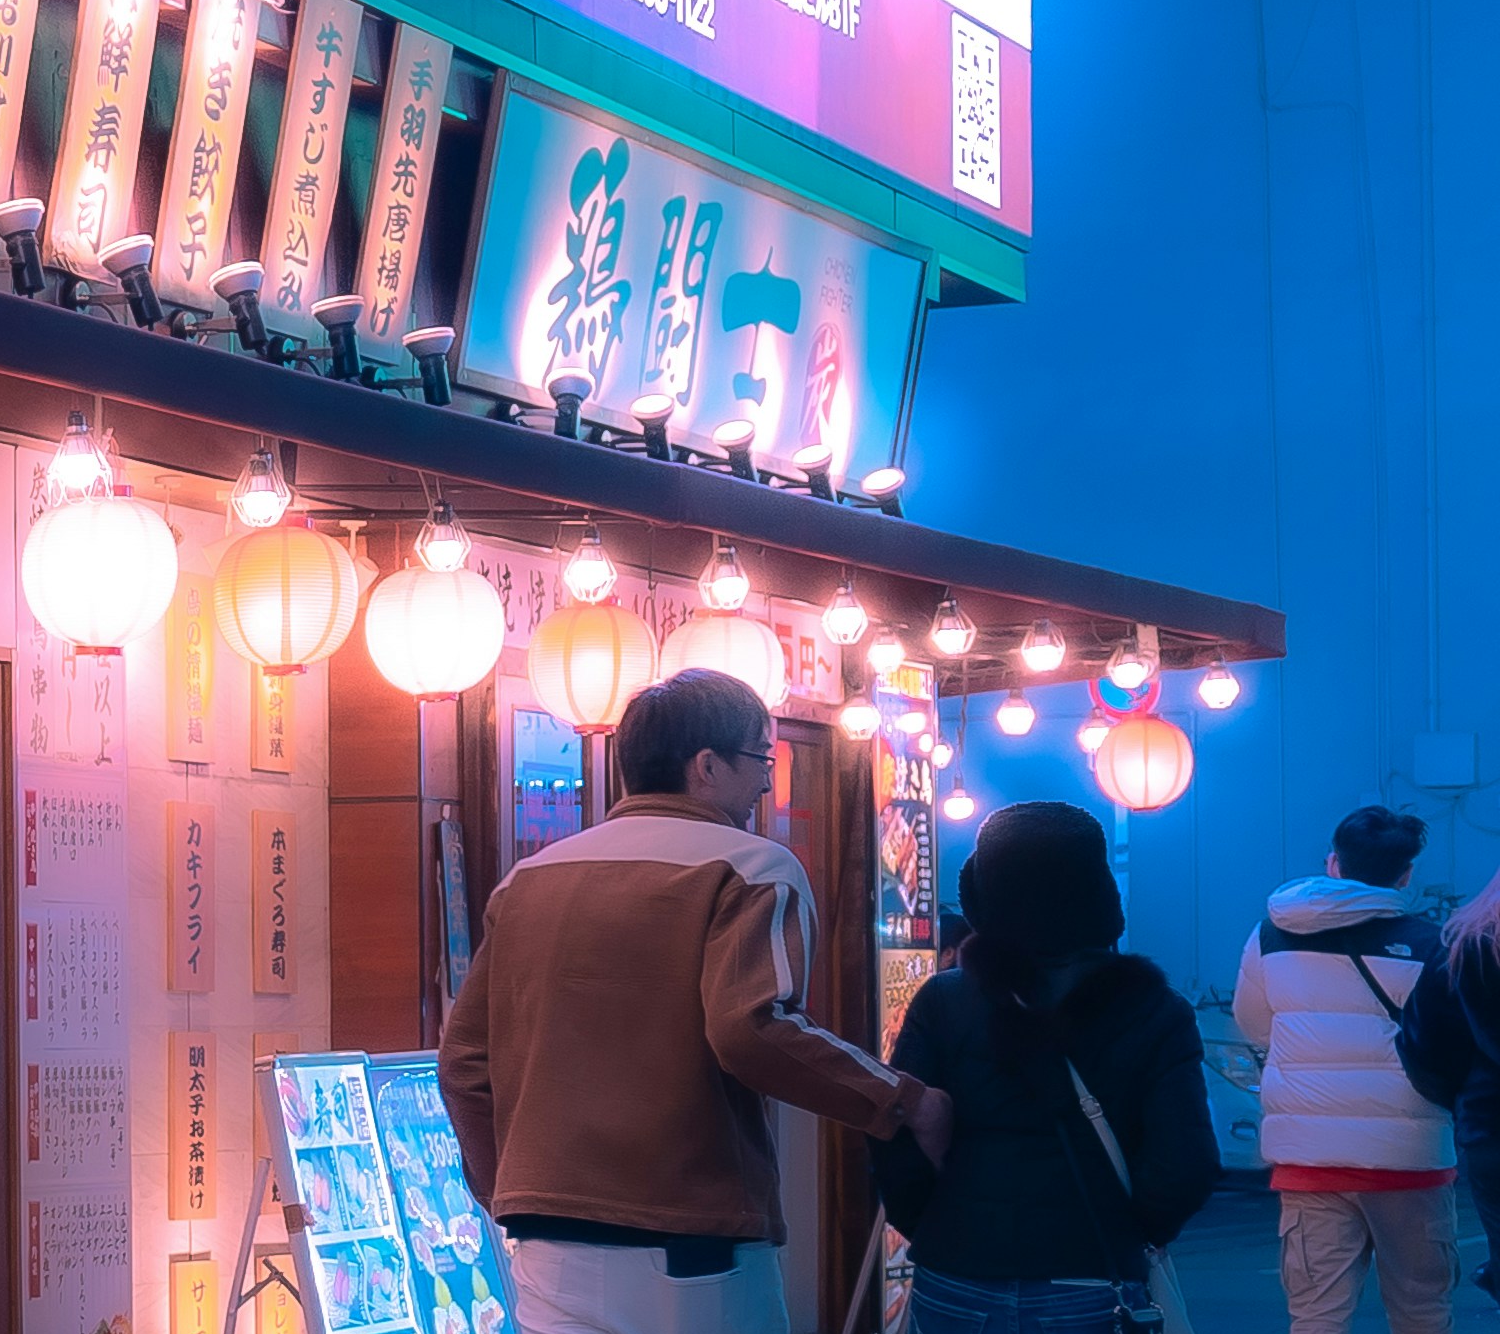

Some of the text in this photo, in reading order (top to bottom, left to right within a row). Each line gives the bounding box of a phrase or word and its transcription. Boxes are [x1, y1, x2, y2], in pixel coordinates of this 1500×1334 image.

[277, 22, 343, 312] 牛すじ煮込み
[370, 61, 433, 338] 手羽先唐揚げ
[185, 818, 203, 977] カキフライ
[271, 826, 287, 981] 本まぐろ寿司
[188, 1046, 206, 1210] 明太子お茶漬け
